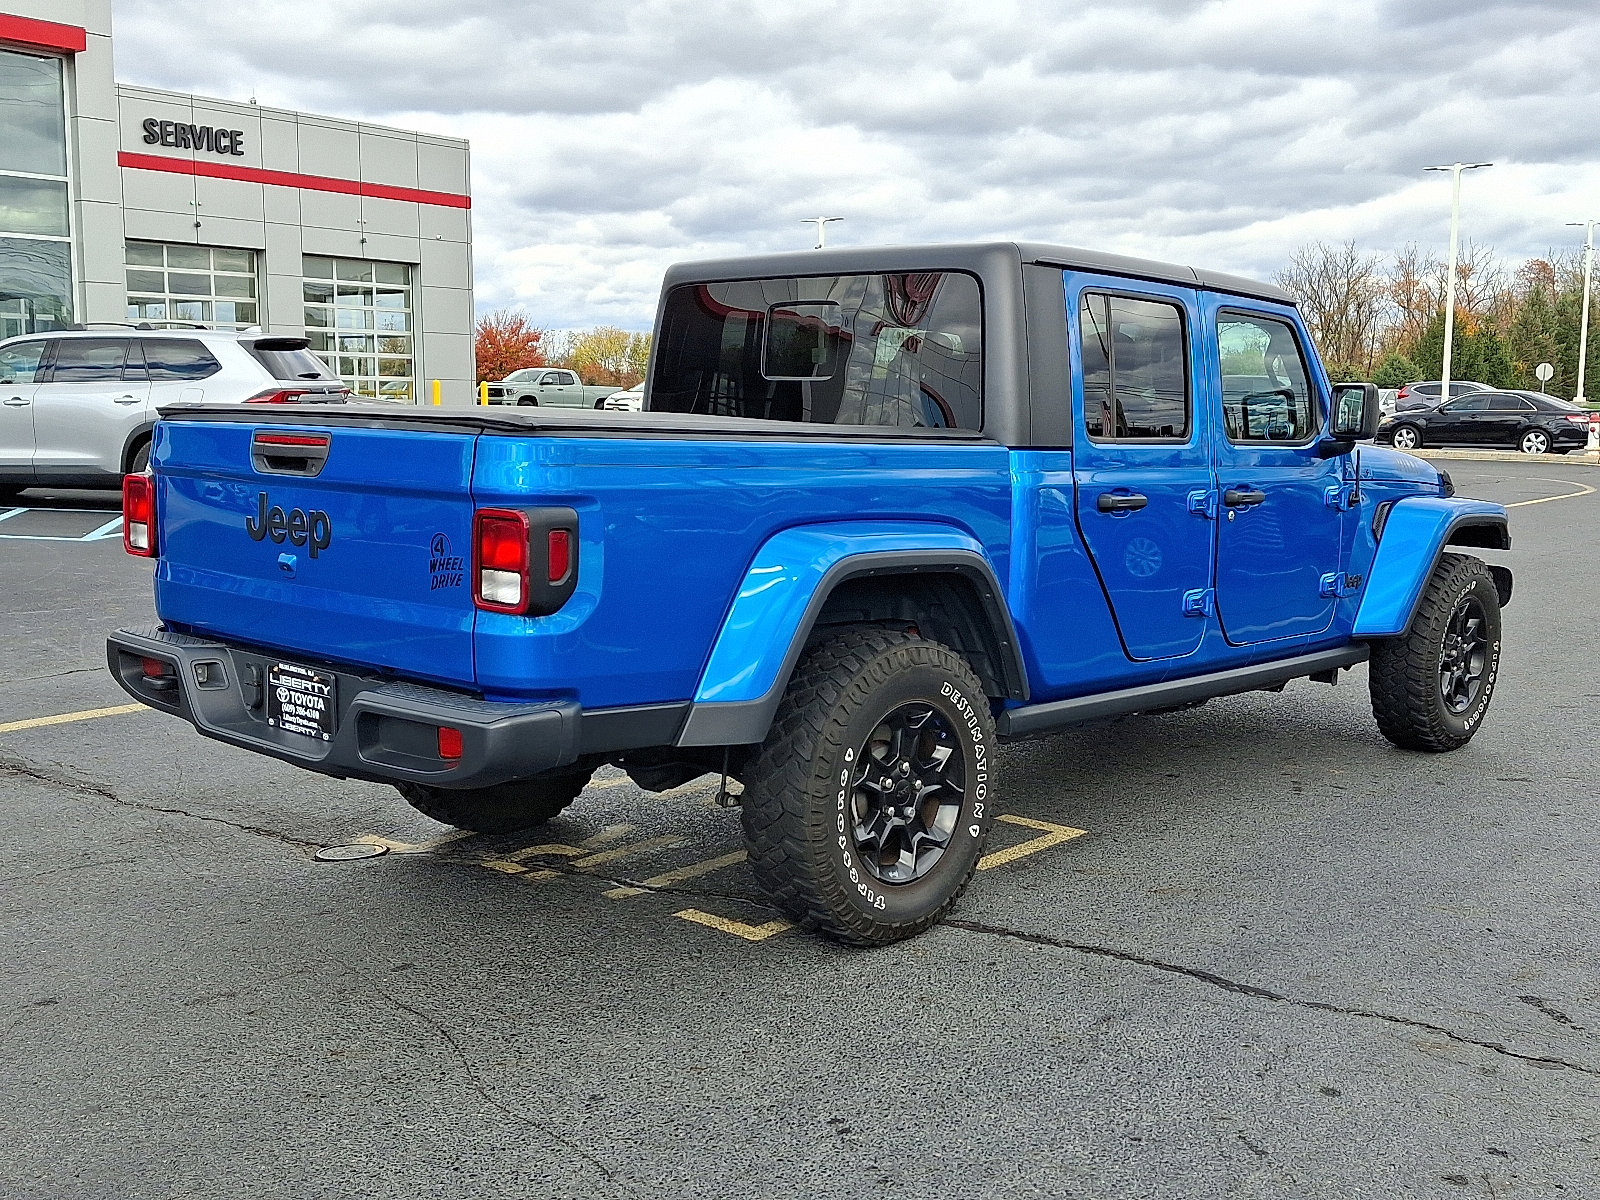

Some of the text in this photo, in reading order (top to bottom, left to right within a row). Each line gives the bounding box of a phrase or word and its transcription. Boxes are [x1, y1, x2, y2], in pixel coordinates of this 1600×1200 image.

[142, 117, 244, 156] SERVICE
[246, 491, 331, 558] Jeep
[429, 556, 463, 573] WHEEL
[431, 573, 462, 591] DRIVE
[270, 673, 330, 695] LIBERTY
[290, 691, 325, 711] TOYOTA
[280, 722, 316, 736] LIBERTY
[941, 681, 987, 818] DESTINATION
